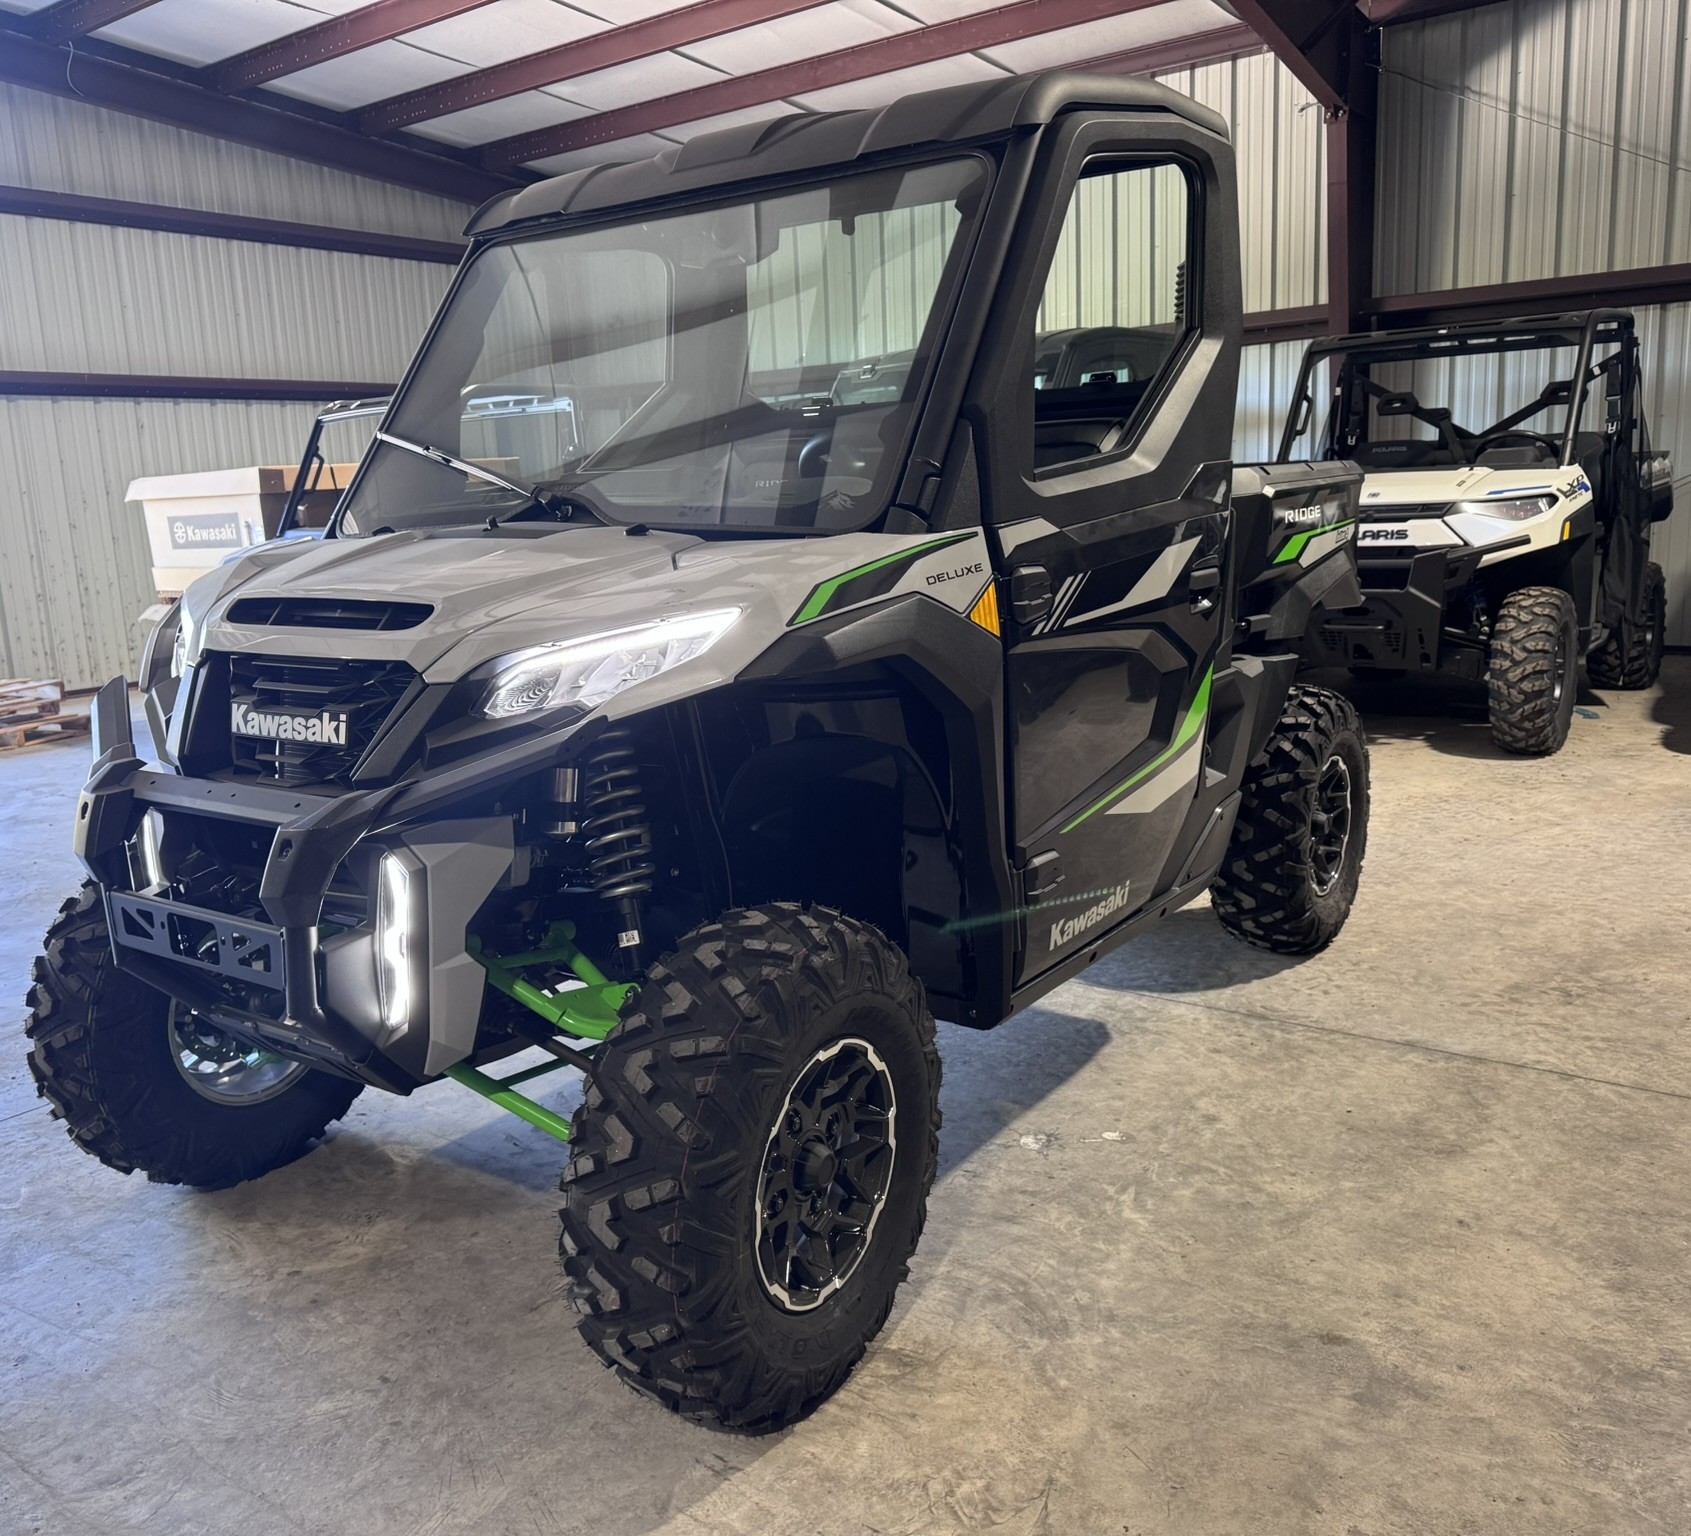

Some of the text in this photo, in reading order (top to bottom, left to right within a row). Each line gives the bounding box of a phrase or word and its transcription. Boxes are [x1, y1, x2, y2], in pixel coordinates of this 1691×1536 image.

[1284, 505, 1321, 524] RIDGE
[186, 524, 237, 541] Kawasaki
[1358, 529, 1409, 541] ARIS
[926, 563, 983, 585] DELUXE
[231, 703, 347, 744] Kawasaki
[1049, 879, 1130, 951] Kawasaki
